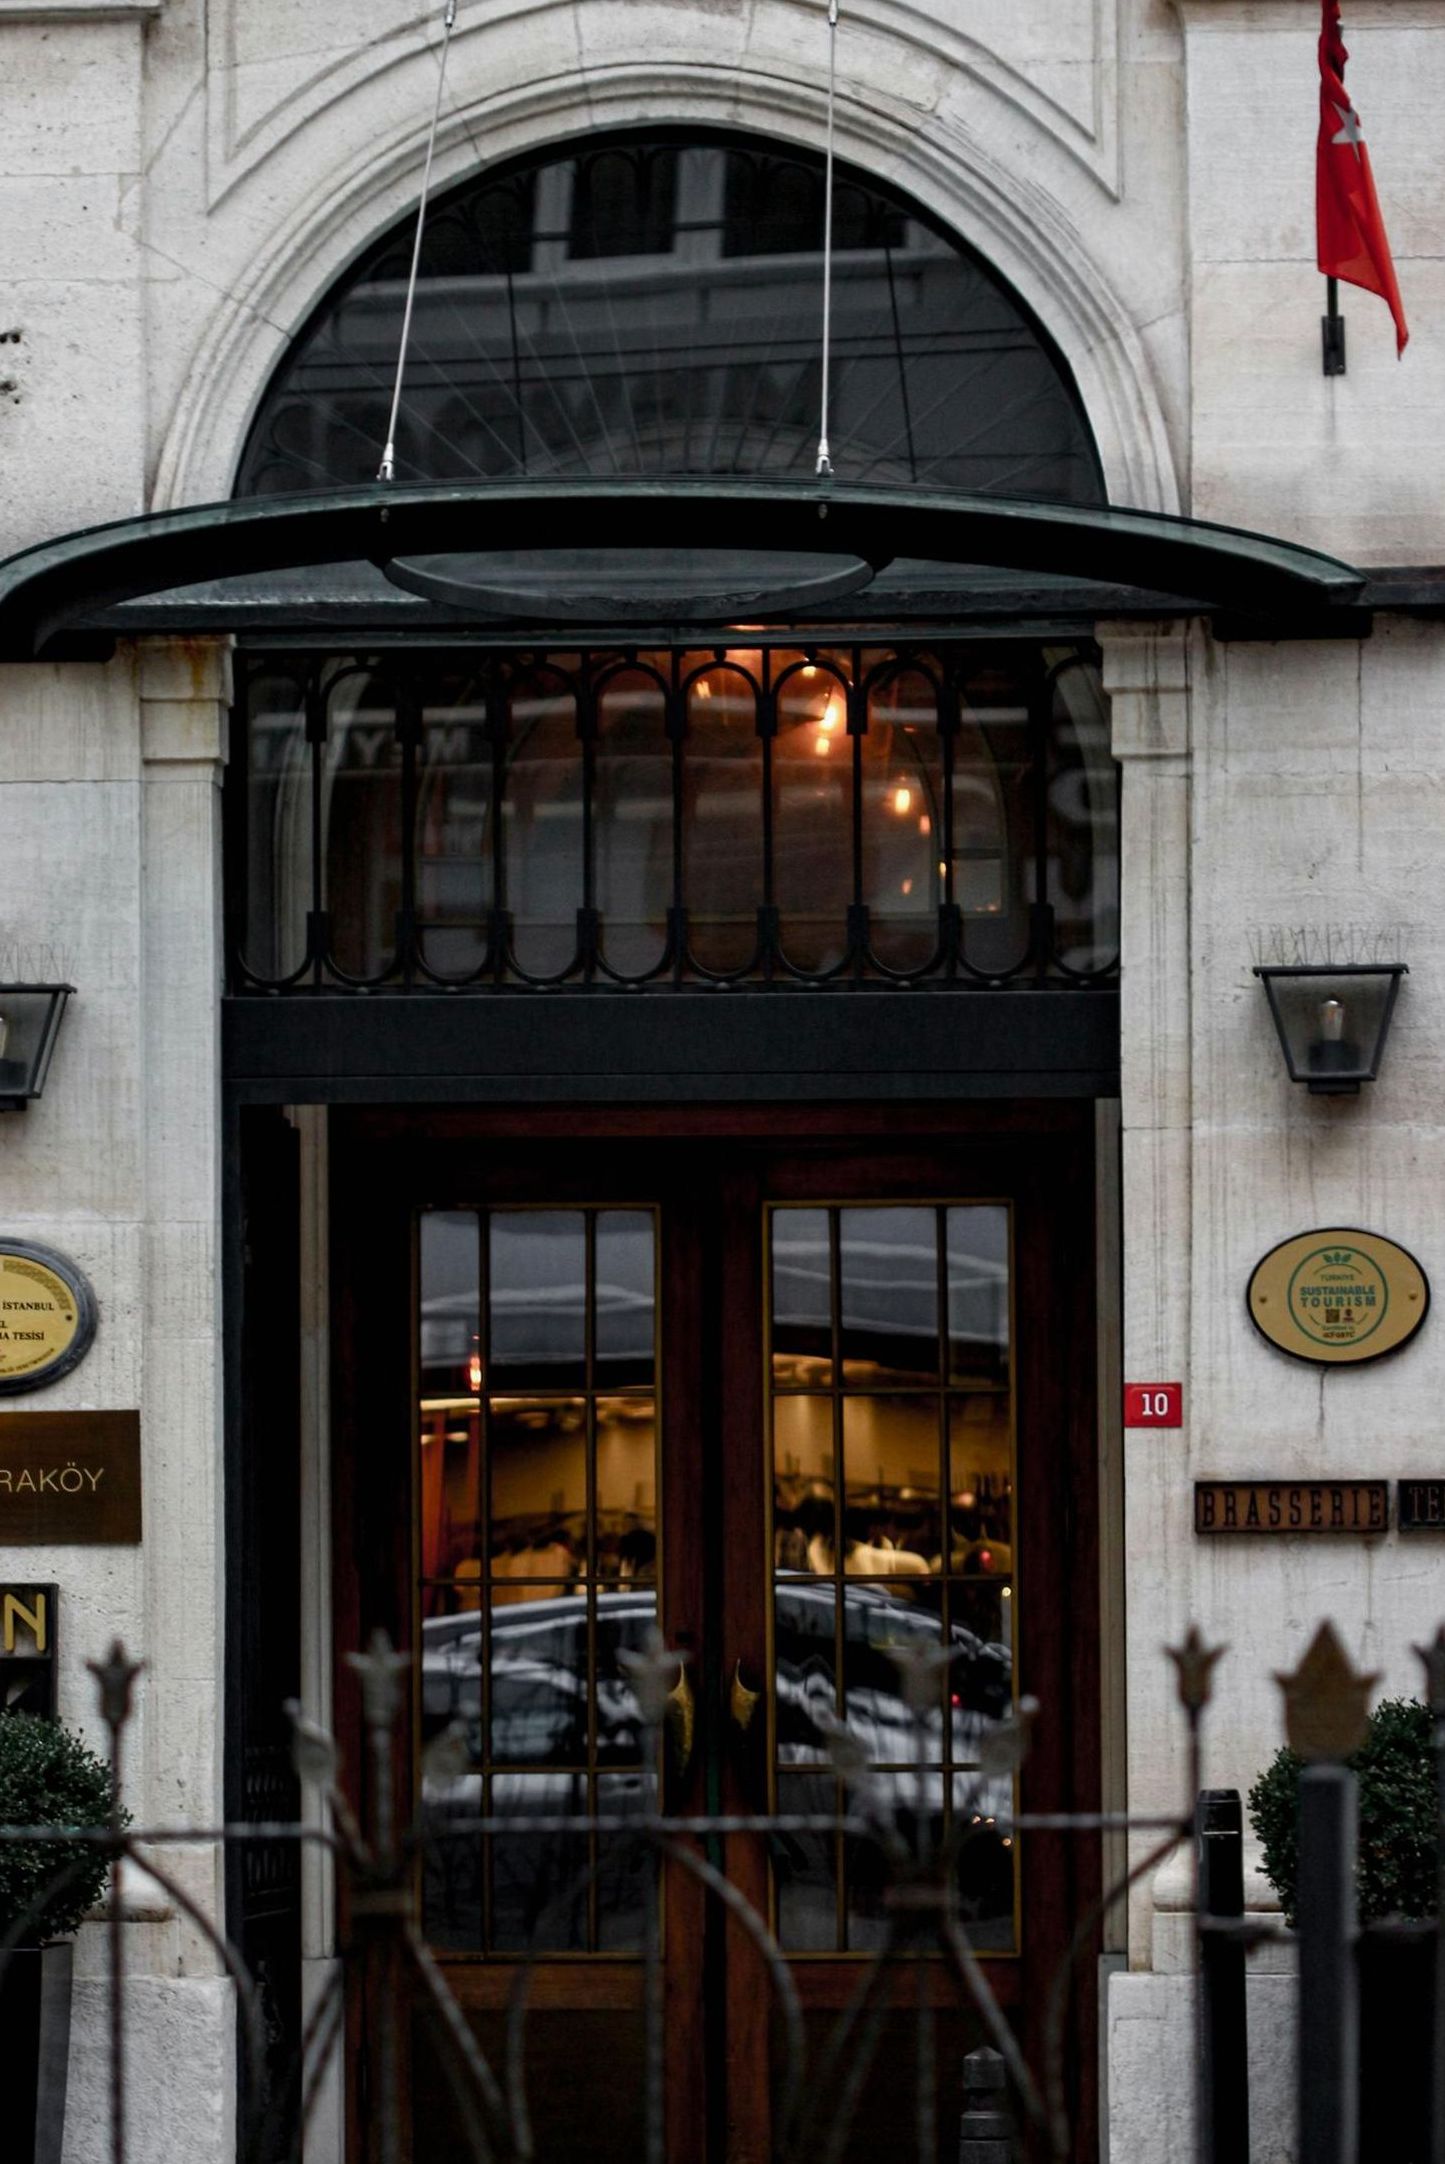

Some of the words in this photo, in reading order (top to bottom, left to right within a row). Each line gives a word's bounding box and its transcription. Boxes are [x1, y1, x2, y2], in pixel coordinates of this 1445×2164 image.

[1300, 1285, 1376, 1296] SUSTAINABLE
[1301, 1296, 1377, 1308] TOURISM
[1141, 1392, 1169, 1416] 10
[0, 1462, 104, 1493] RAKÖY
[1202, 1488, 1382, 1528] BRASSERIE
[1408, 1486, 1445, 1523] TE
[3, 1593, 46, 1651] N
